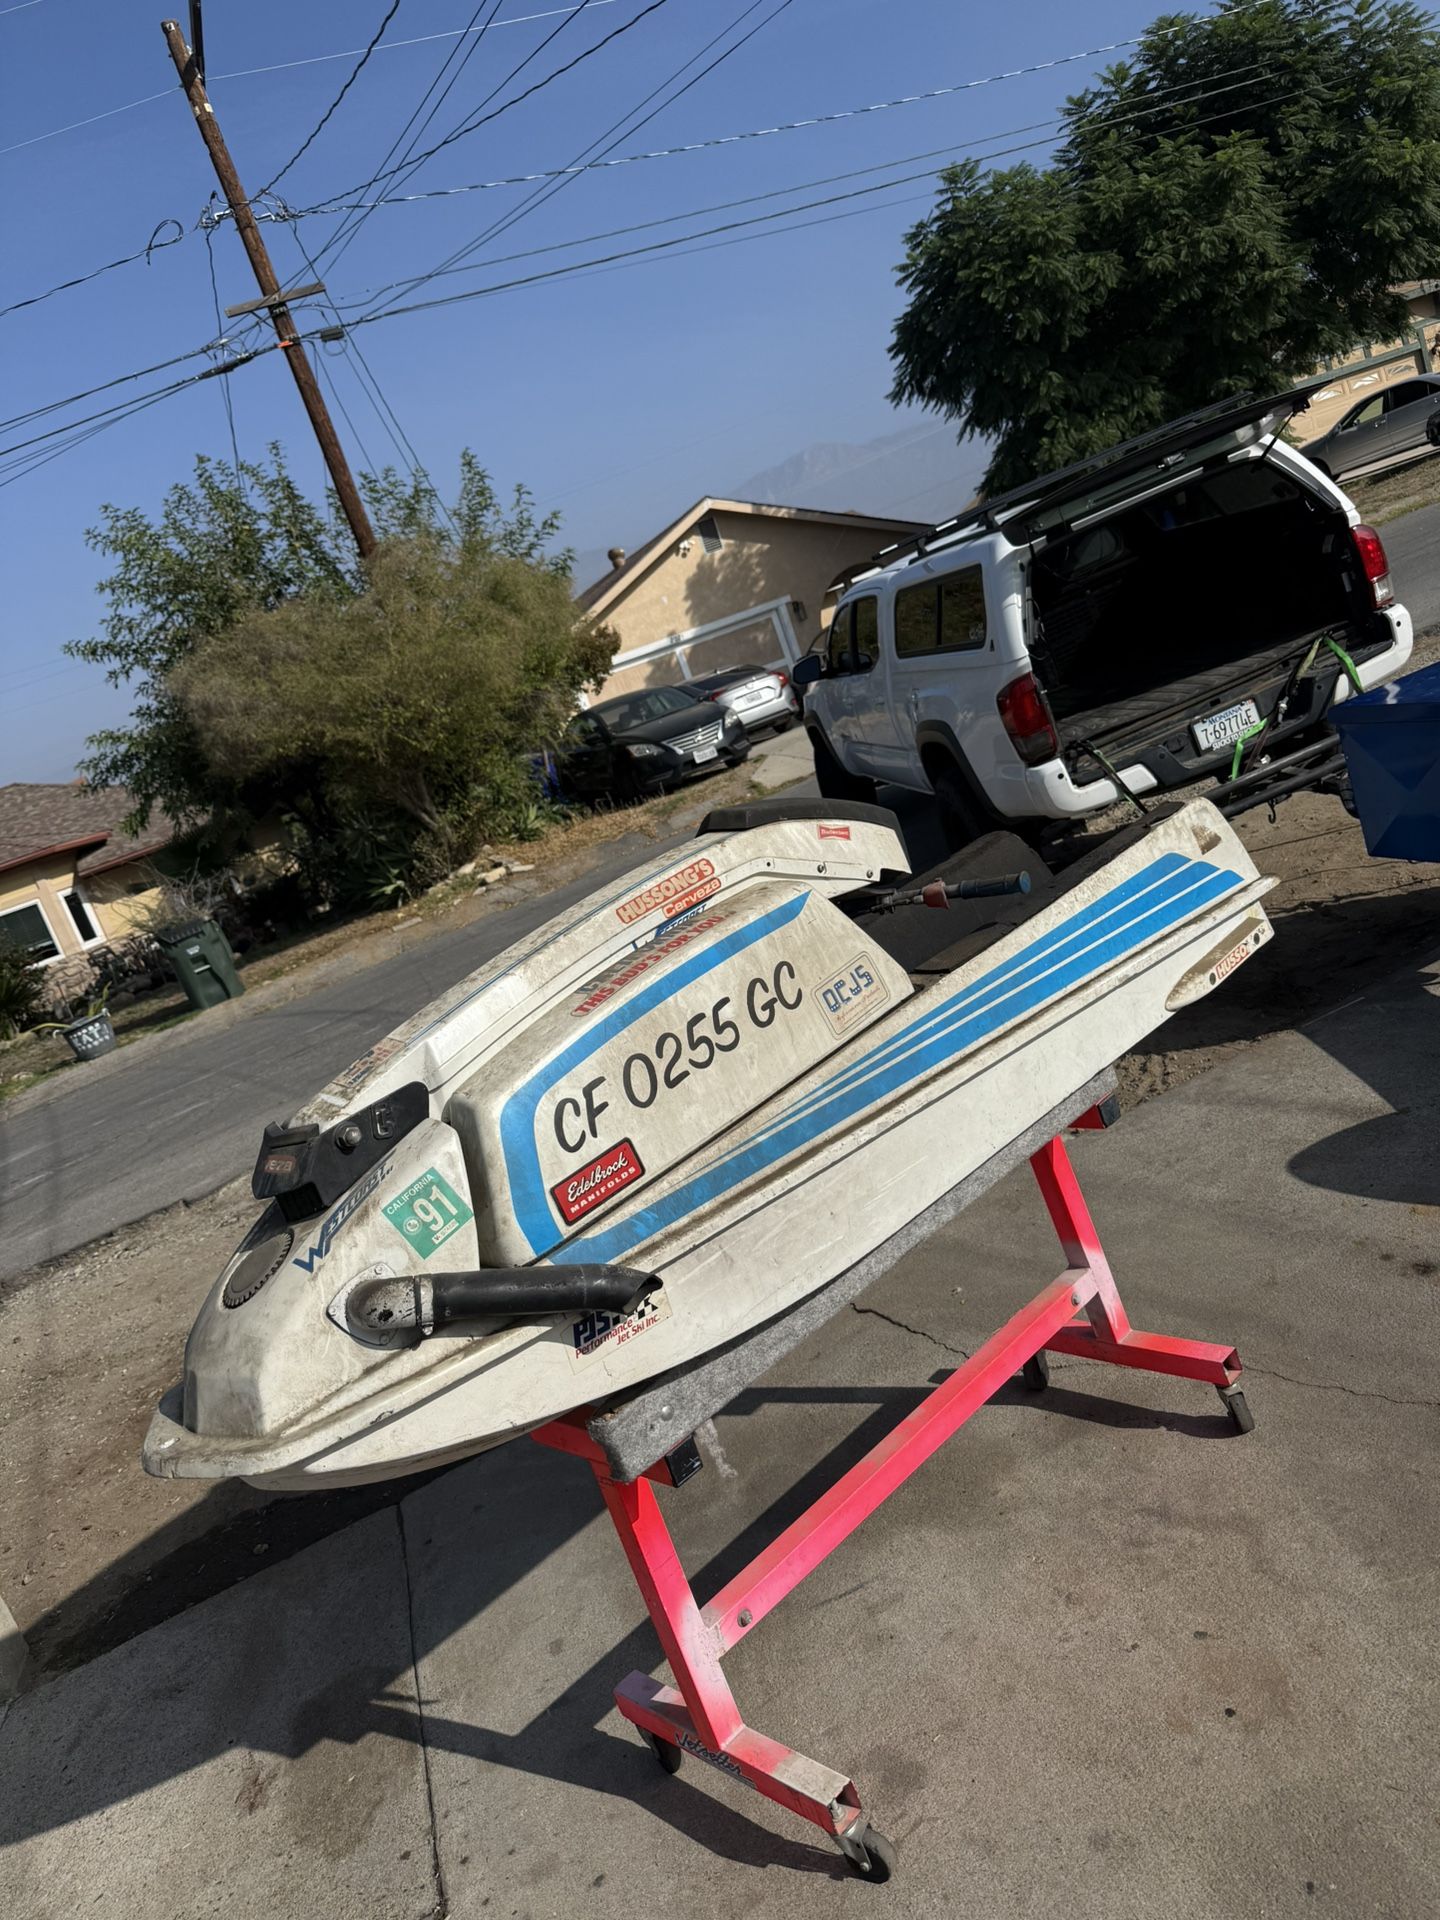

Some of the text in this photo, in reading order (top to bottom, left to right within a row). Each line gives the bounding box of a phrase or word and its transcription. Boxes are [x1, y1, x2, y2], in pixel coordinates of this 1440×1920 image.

[1208, 706, 1243, 725] MONTANA
[617, 859, 714, 923] HUSSONG'S
[663, 878, 721, 917] Cerveza
[574, 986, 615, 1014] THIS
[611, 953, 662, 987] BUD'S
[660, 933, 690, 955] FOR
[554, 1075, 609, 1154] CF
[622, 996, 741, 1109] 0255
[746, 960, 803, 1029] GC
[386, 1173, 435, 1215] CALIFORNIA
[567, 1151, 629, 1202] Edelbrock
[570, 1166, 636, 1214] MANIFOLDS
[412, 1184, 459, 1232] 91
[575, 1318, 633, 1360] Performance
[616, 1332, 631, 1346] Jet
[631, 1320, 645, 1337] Ski
